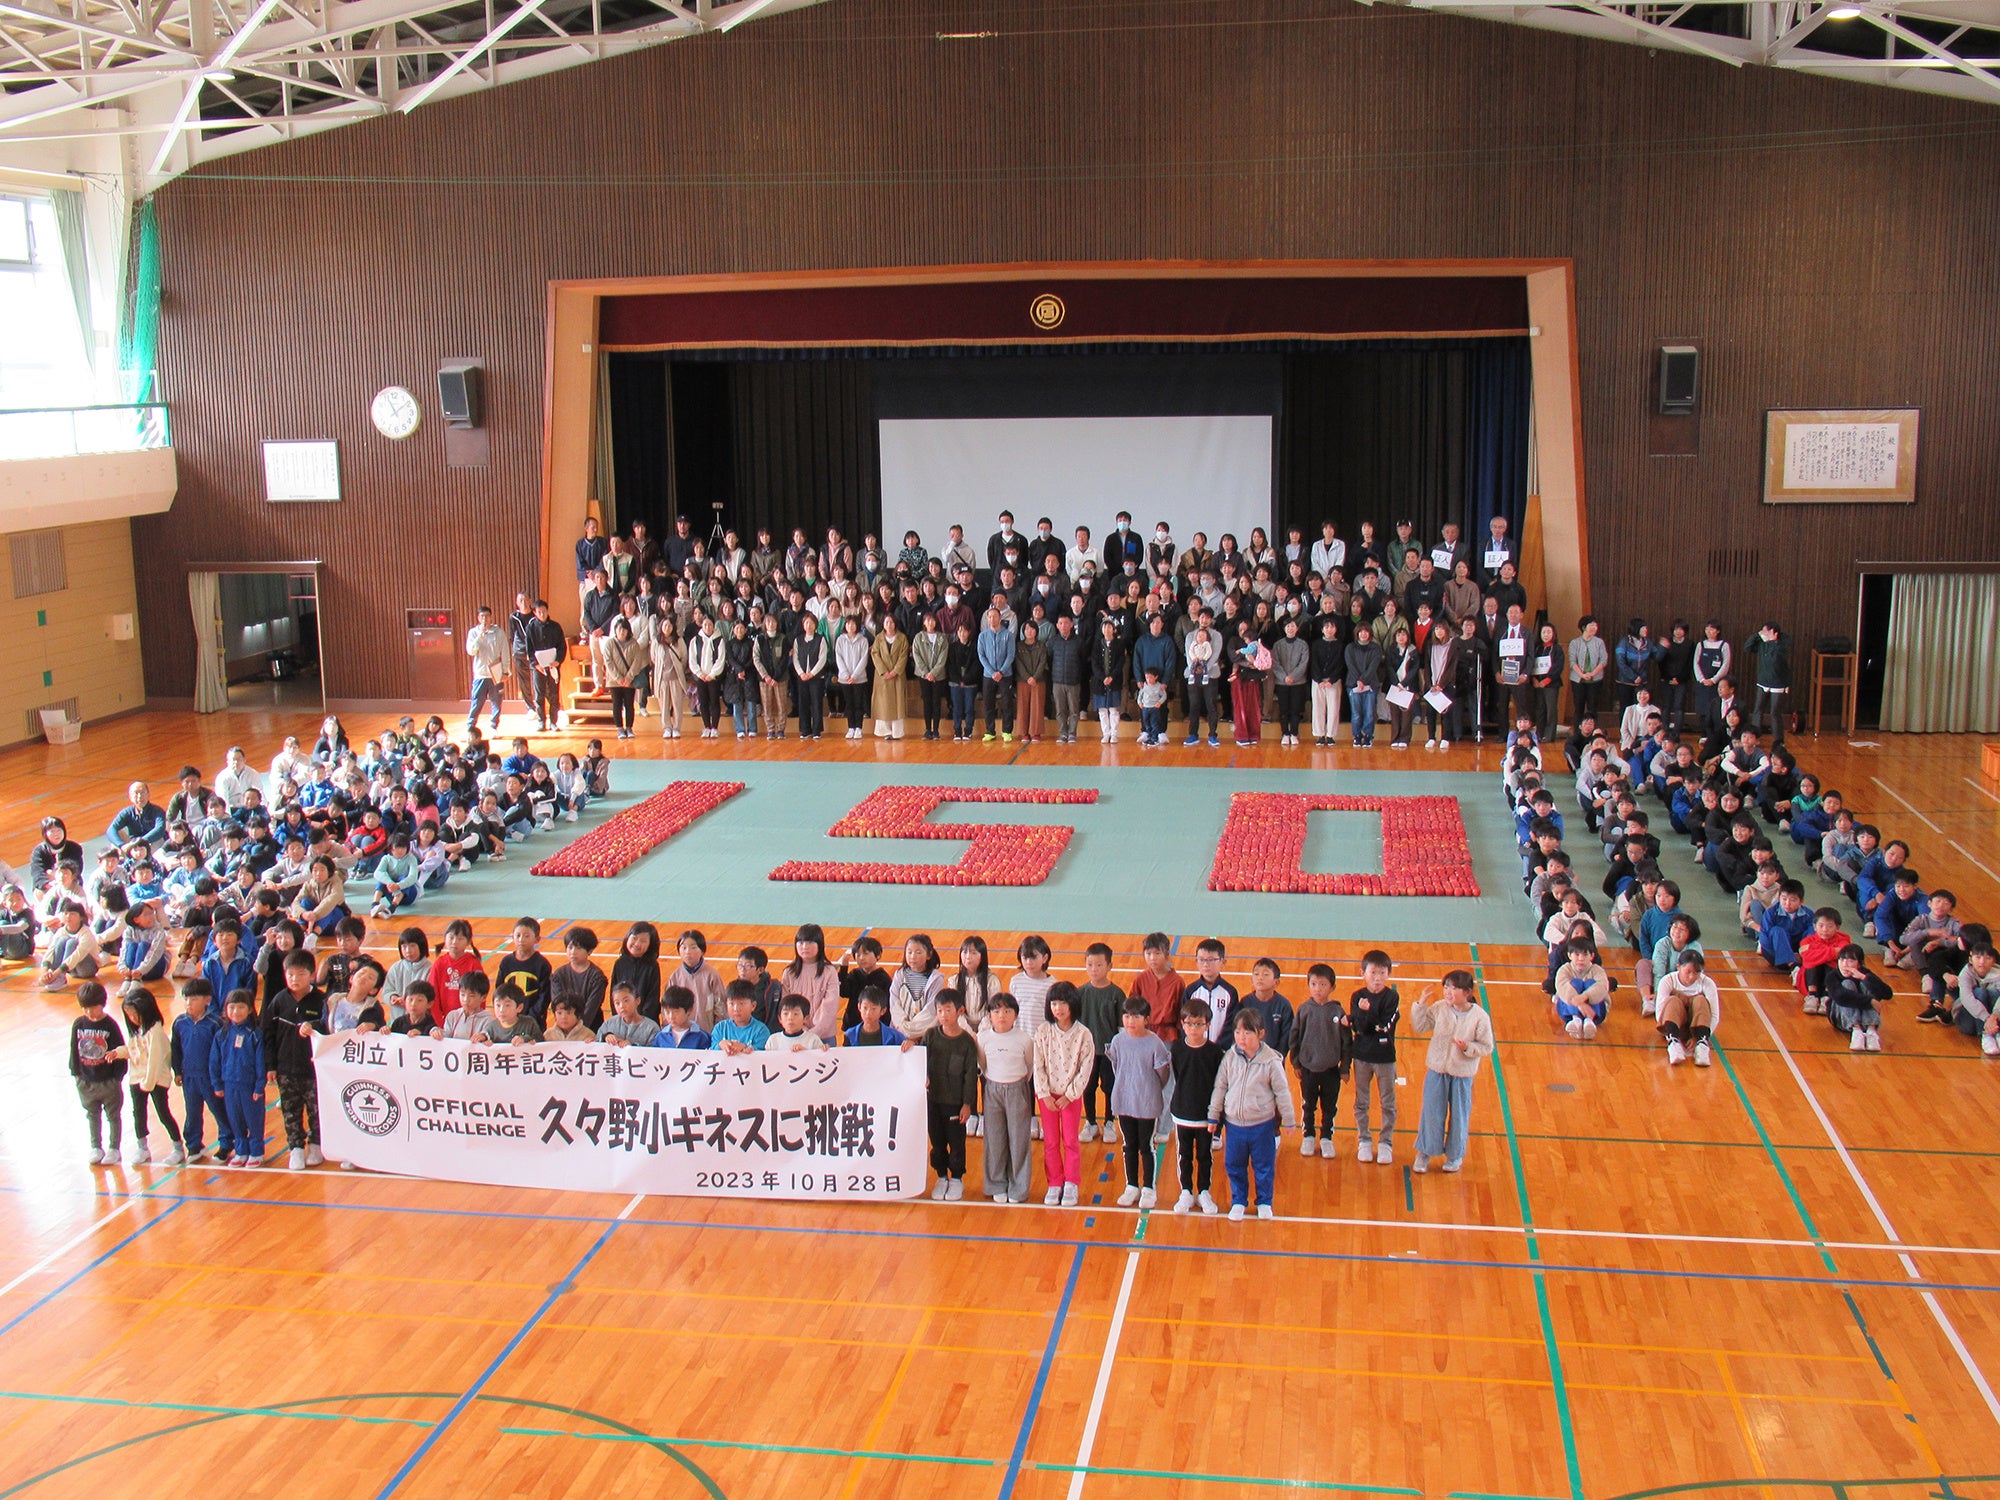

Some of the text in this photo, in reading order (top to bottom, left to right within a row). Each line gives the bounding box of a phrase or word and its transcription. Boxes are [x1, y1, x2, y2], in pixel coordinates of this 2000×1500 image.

[1217, 999, 1226, 1008] 19
[347, 1082, 390, 1100] GUINNESS
[345, 1102, 398, 1133] WORLD RECORDS
[414, 1096, 524, 1119] OFFICIAL
[416, 1117, 526, 1138] CHALLENGE
[539, 1097, 899, 1158] 久々野小ギネスに挑戦！
